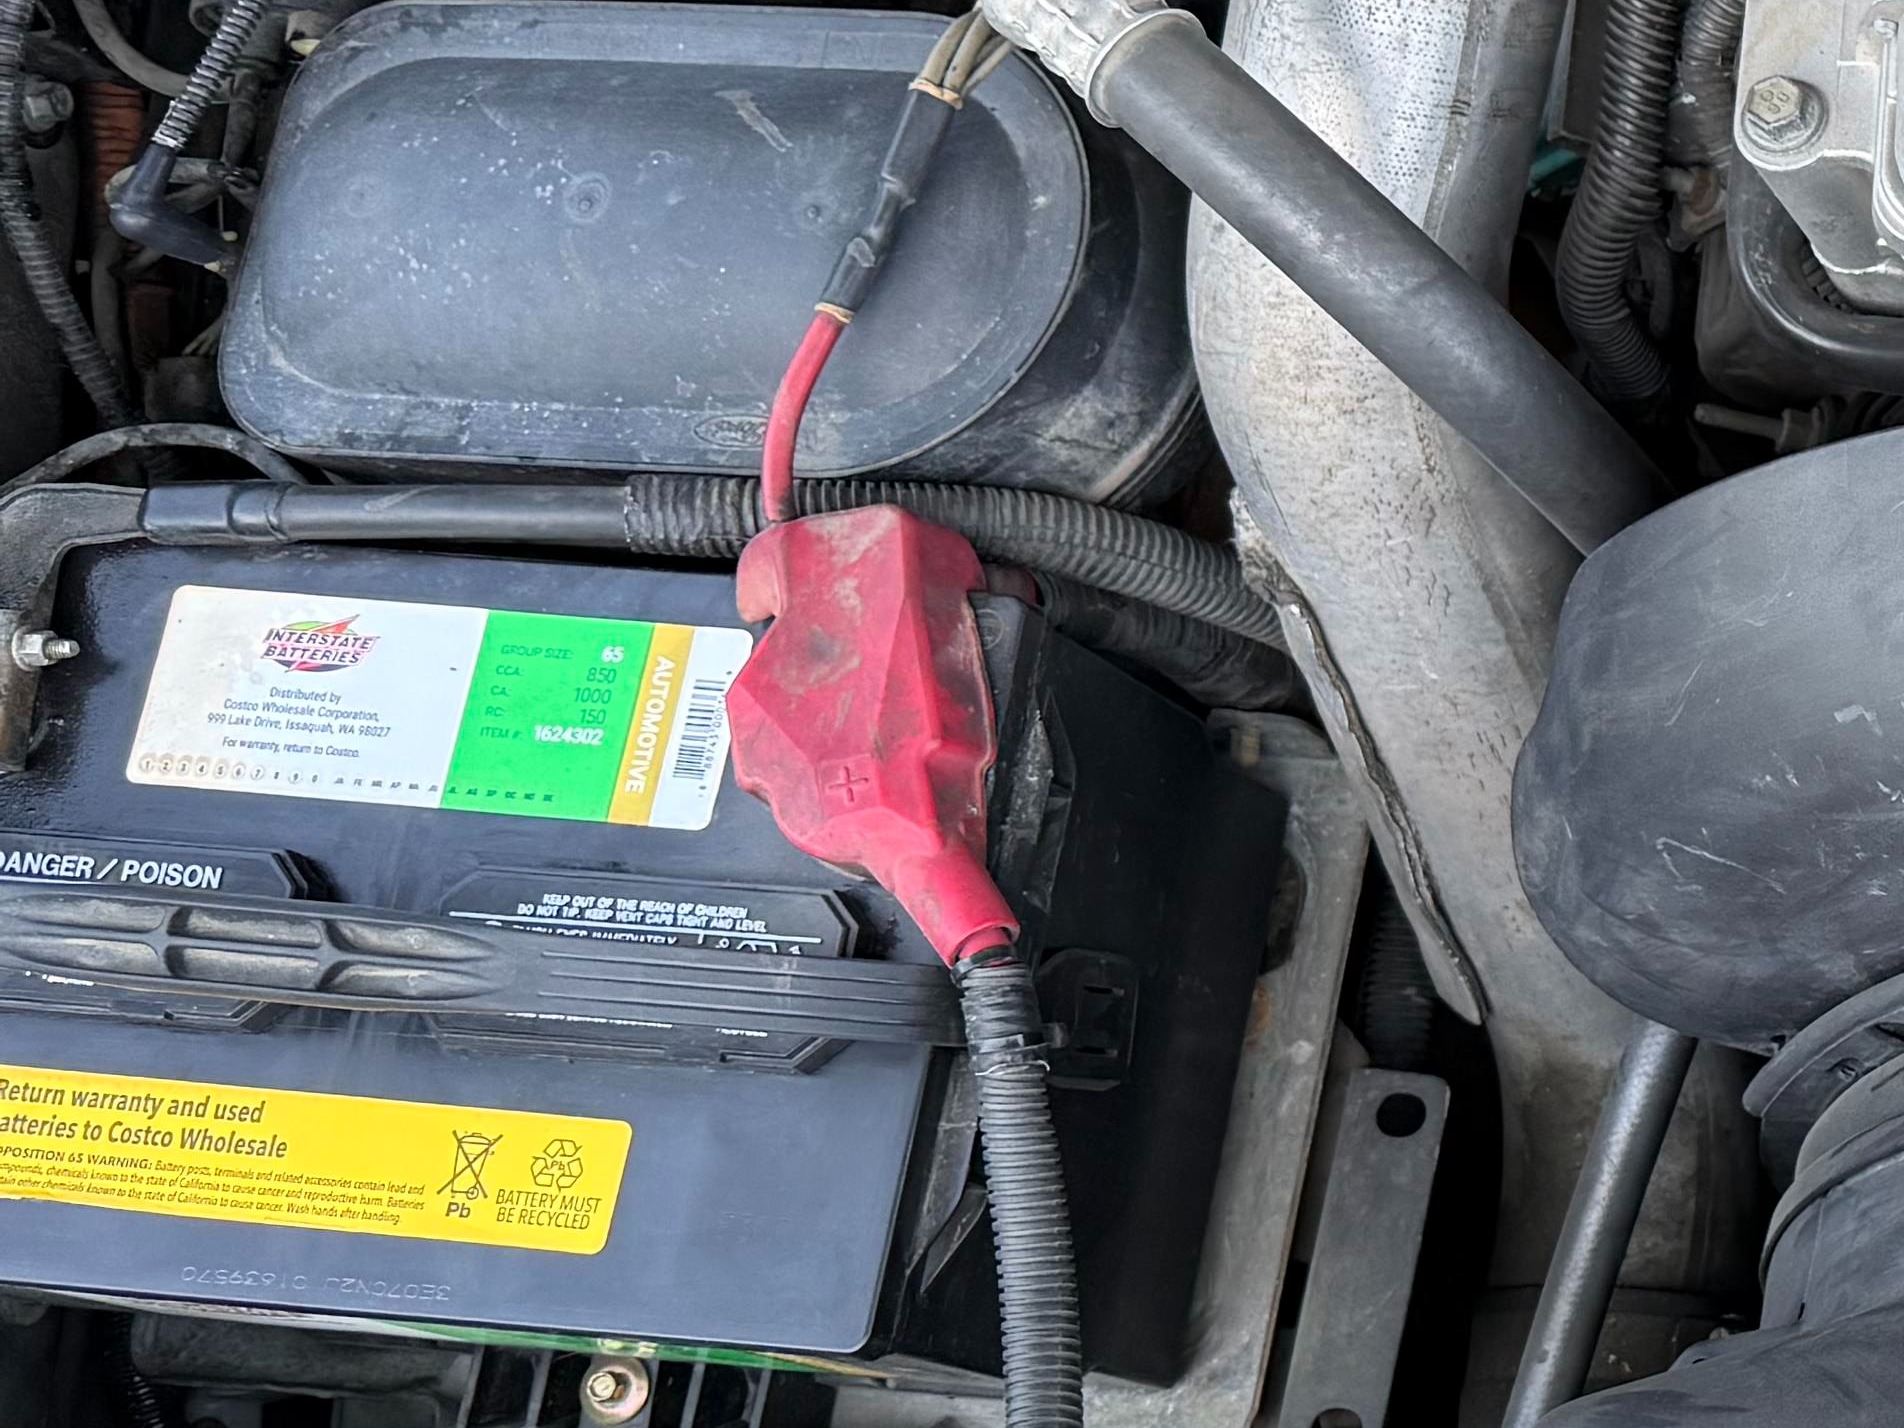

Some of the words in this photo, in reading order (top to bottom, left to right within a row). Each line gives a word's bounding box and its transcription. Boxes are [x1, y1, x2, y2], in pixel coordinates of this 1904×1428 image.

[263, 628, 374, 650] INTERSTATE
[262, 645, 364, 664] BATTERIES
[501, 645, 542, 657] GROUP
[544, 648, 573, 659] SIZE:
[602, 646, 624, 663] 65
[496, 665, 523, 677] CCA:
[586, 667, 616, 684] 850
[270, 687, 327, 703] Distributed
[329, 692, 342, 705] by
[490, 686, 510, 697] CA:
[574, 687, 612, 704] 1000
[224, 699, 258, 712] Costco
[260, 701, 315, 716] Wholesale
[485, 706, 504, 717] RC:
[579, 709, 606, 724] 150
[208, 712, 227, 724] 999
[228, 714, 252, 727] Lake
[338, 723, 355, 735] WA
[358, 724, 391, 738] 98027
[480, 727, 508, 739] ITEM
[533, 725, 604, 745] 1624302
[624, 656, 675, 794] AUTOMOTIVE
[222, 736, 237, 748] For
[283, 741, 311, 754] return
[121, 860, 222, 889] POISON
[543, 894, 569, 906] KEEP
[573, 896, 595, 908] OUT
[598, 897, 612, 909] OF
[617, 899, 637, 911] THE
[640, 901, 674, 913] REACH
[678, 903, 694, 915] OF
[697, 905, 748, 918] CHILDREN
[71, 1092, 164, 1120] warranty
[167, 1095, 211, 1119] and
[214, 1100, 266, 1123] used
[83, 1120, 102, 1140] to
[108, 1121, 173, 1148] Costco
[180, 1127, 288, 1159] Wholesale
[67, 1152, 84, 1164] 65
[87, 1154, 152, 1169] WARNING:
[155, 1161, 186, 1176] Battery
[215, 1167, 254, 1180] terminals
[256, 1170, 273, 1181] and
[353, 1180, 386, 1191] contain
[387, 1182, 406, 1193] lead
[407, 1184, 425, 1195] and
[551, 1161, 565, 1171] Pb
[445, 1202, 471, 1218] Pb
[496, 1189, 558, 1208] BATTERY
[560, 1195, 602, 1214] MUST
[496, 1207, 515, 1222] BE
[518, 1208, 590, 1230] RECYCLED
